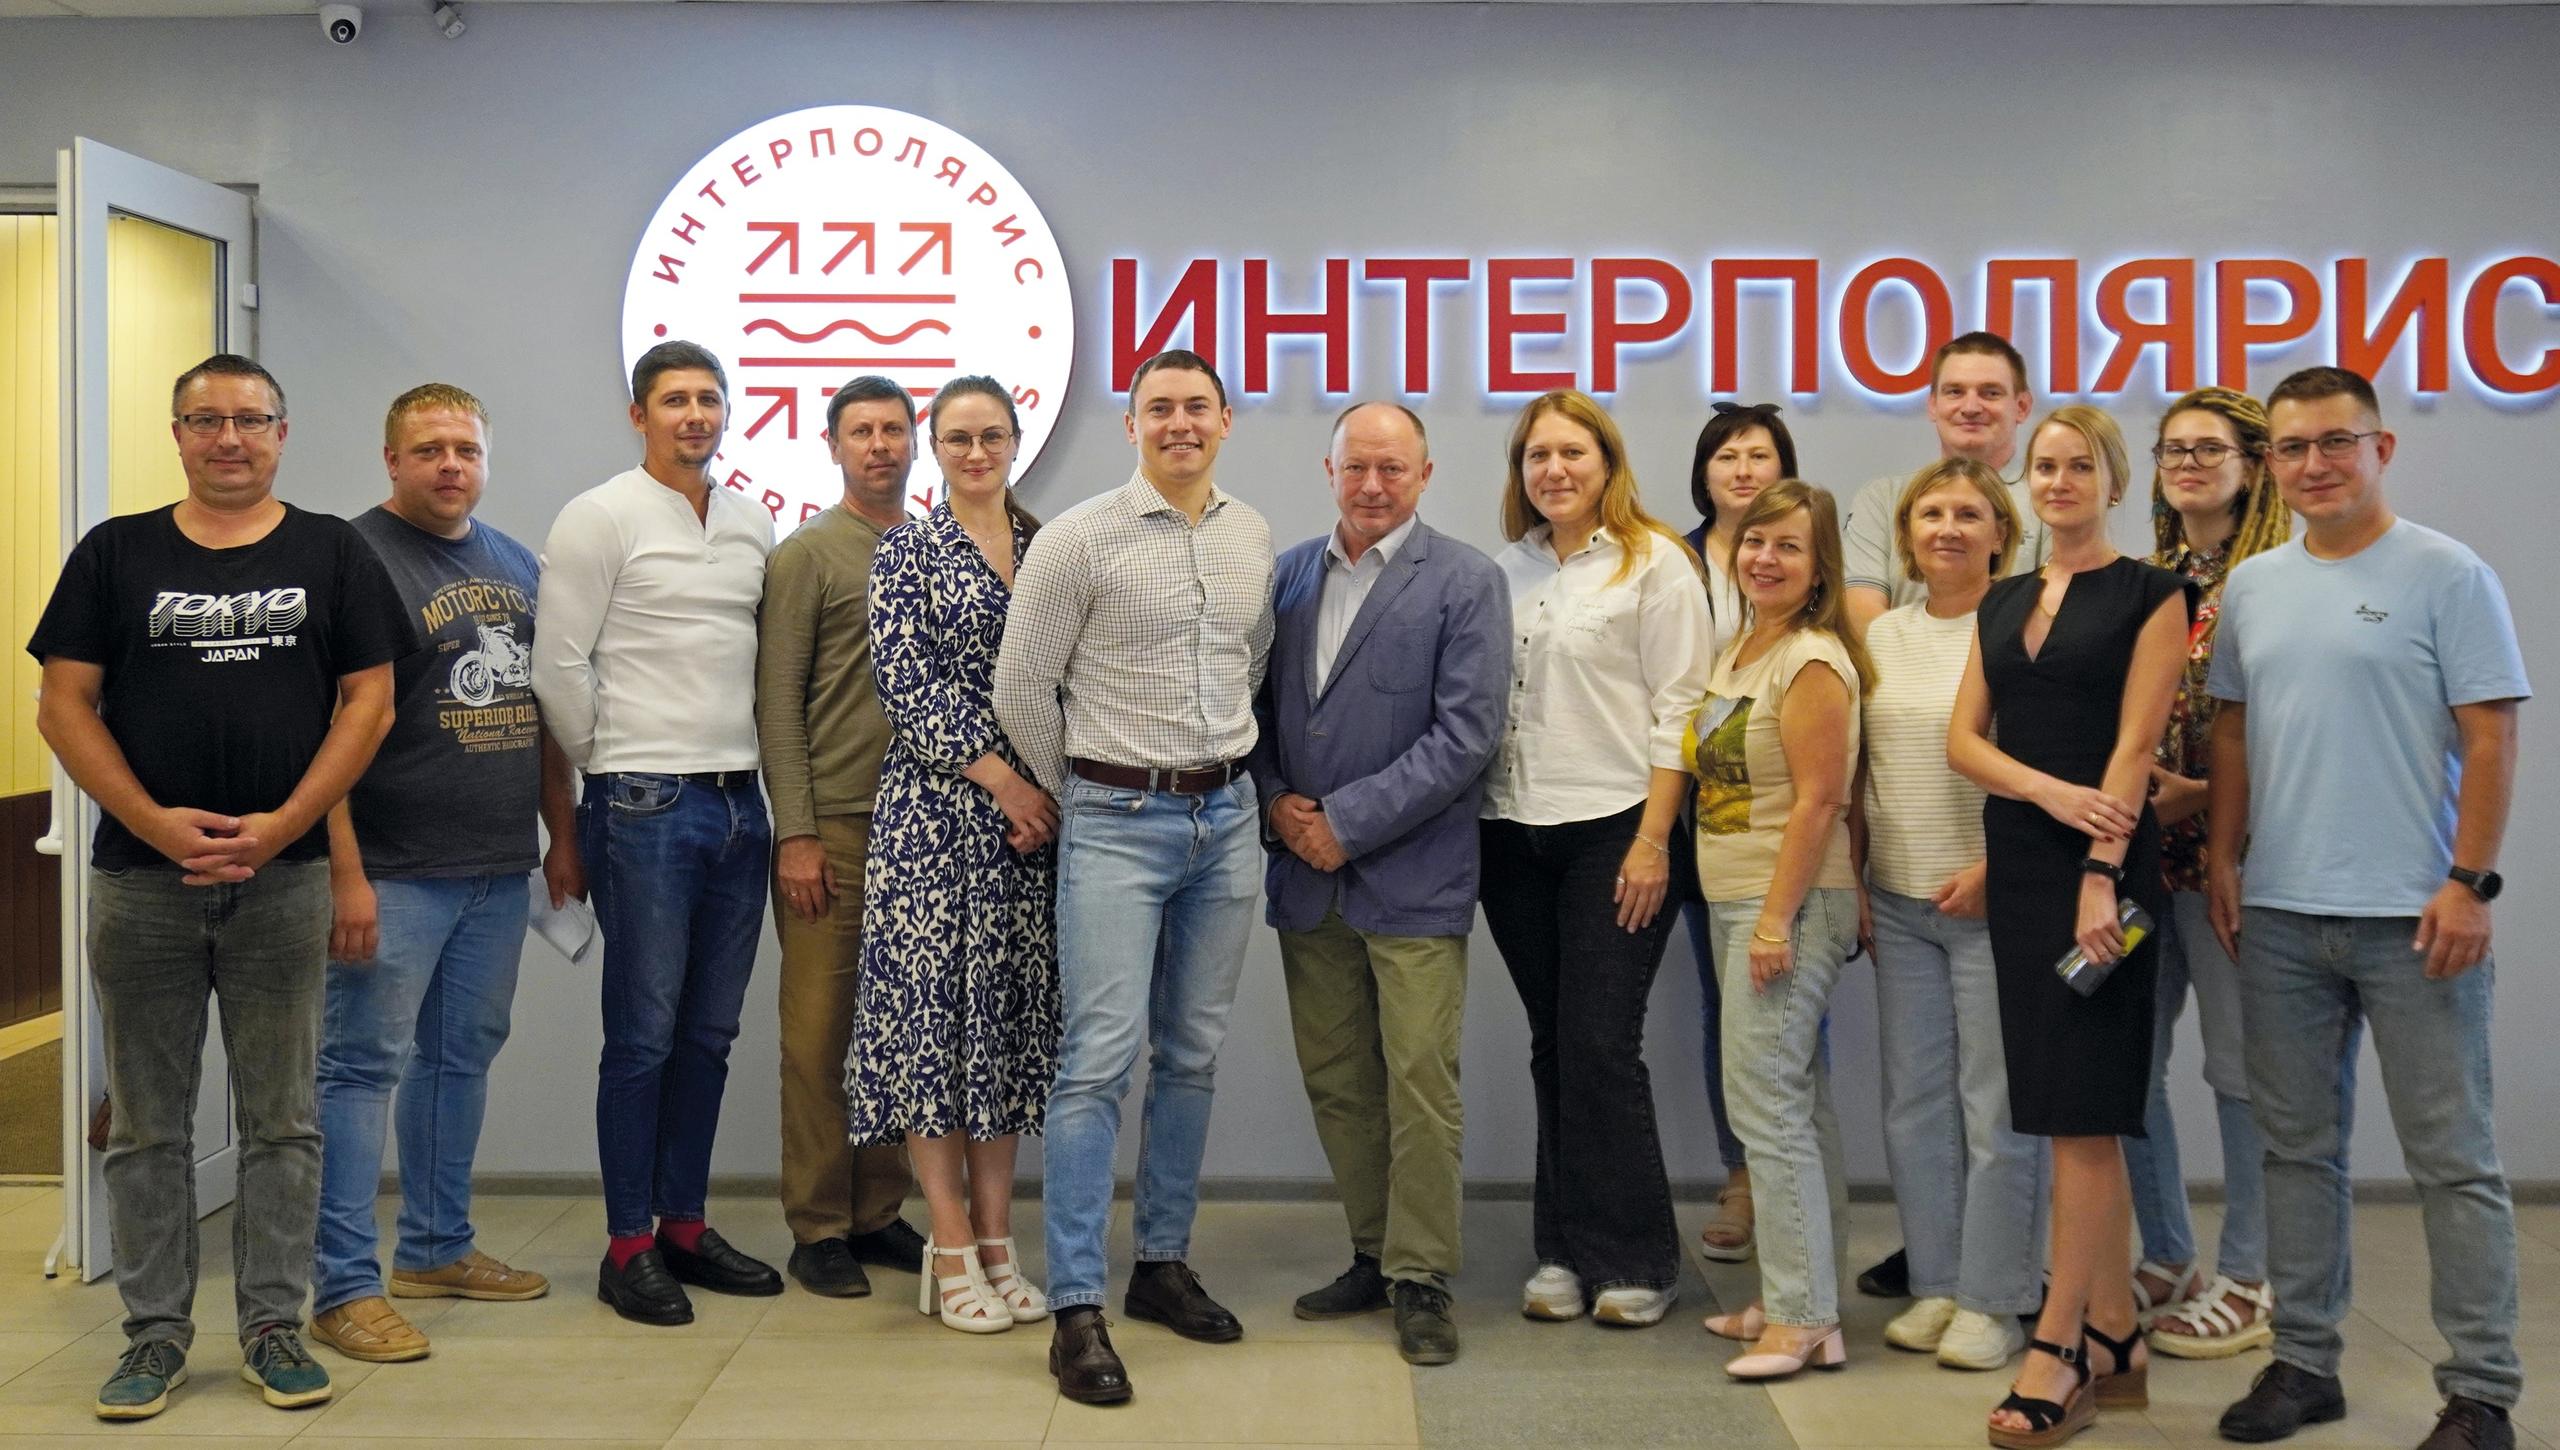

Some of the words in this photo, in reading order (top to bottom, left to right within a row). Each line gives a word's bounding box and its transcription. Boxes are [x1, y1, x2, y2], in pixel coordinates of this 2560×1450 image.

[653, 127, 1043, 285] ИНТЕРПОЛЯРИС
[1112, 256, 2560, 394] ИНТЕРПОЛЯРИС
[149, 587, 308, 637] TOKYO
[271, 635, 297, 647] 東京
[201, 647, 260, 662] JAPAN
[439, 706, 515, 729] SUPERIOR
[455, 725, 505, 740] National
